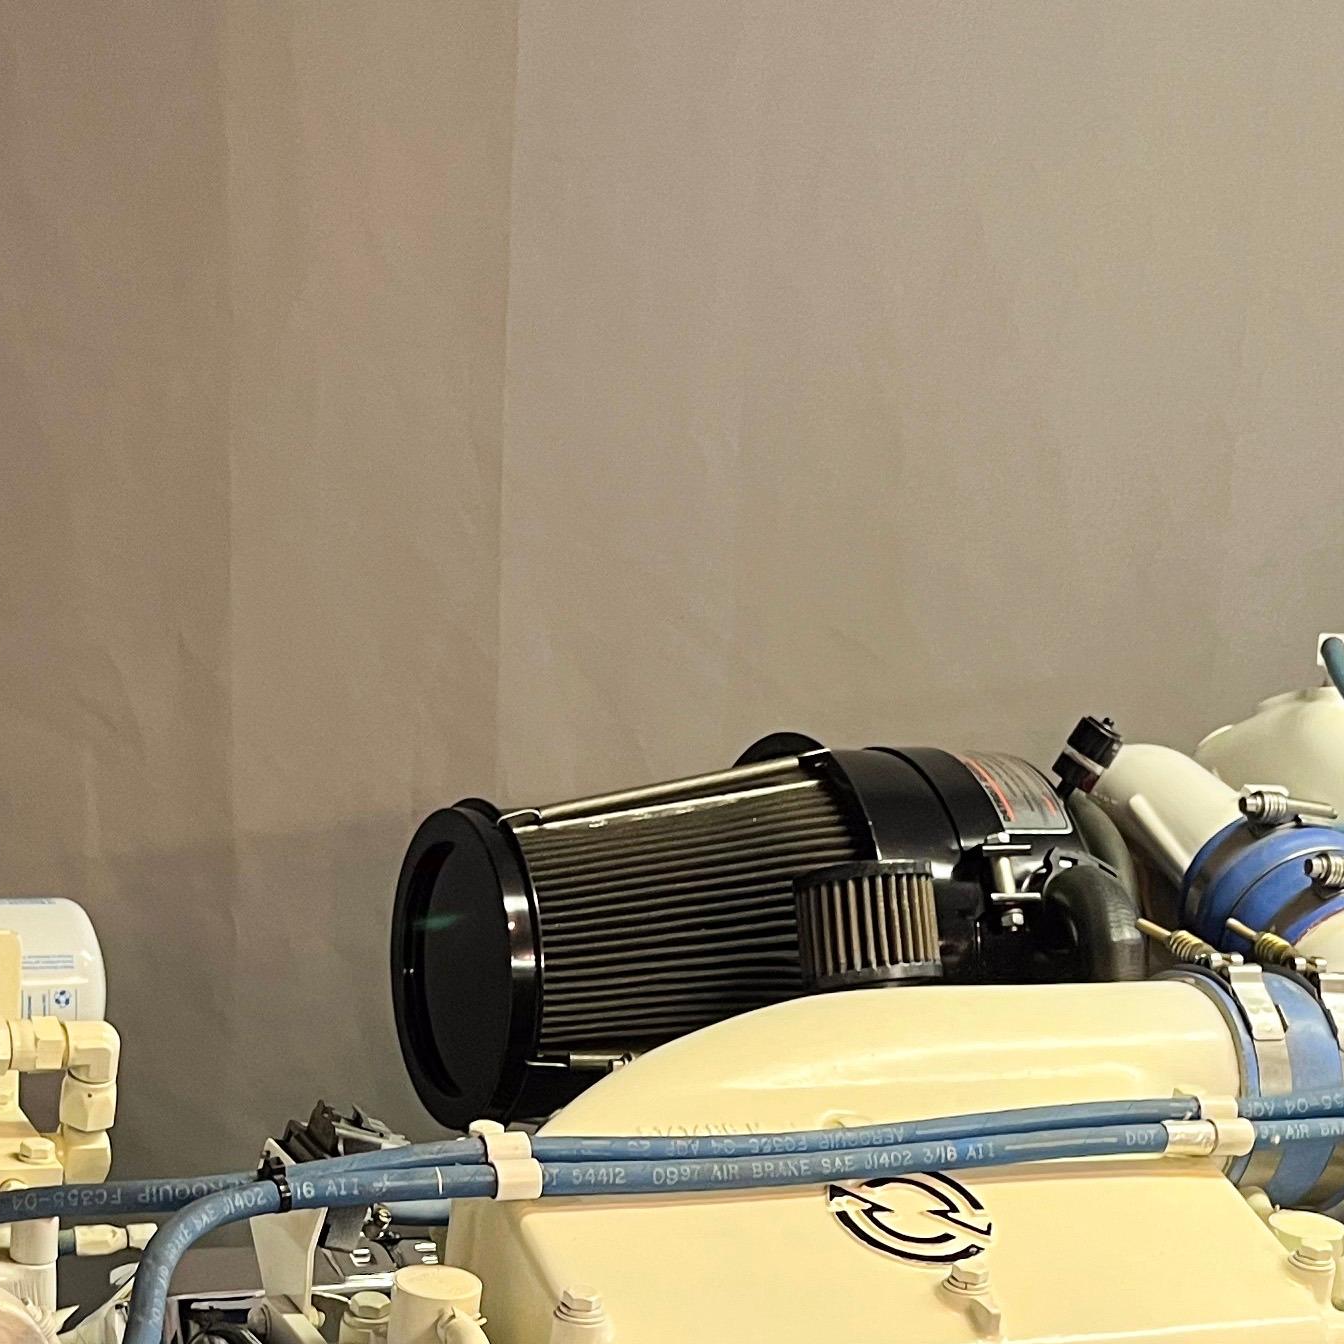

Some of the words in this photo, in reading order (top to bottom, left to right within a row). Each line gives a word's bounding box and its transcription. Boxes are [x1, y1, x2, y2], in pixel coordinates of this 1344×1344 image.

[572, 1166, 627, 1186] 54412
[711, 1163, 740, 1181] AIR
[752, 1159, 812, 1179] BRAKE
[821, 1153, 856, 1174] SAE
[864, 1150, 914, 1170] J1402
[1124, 1131, 1157, 1147] DOT
